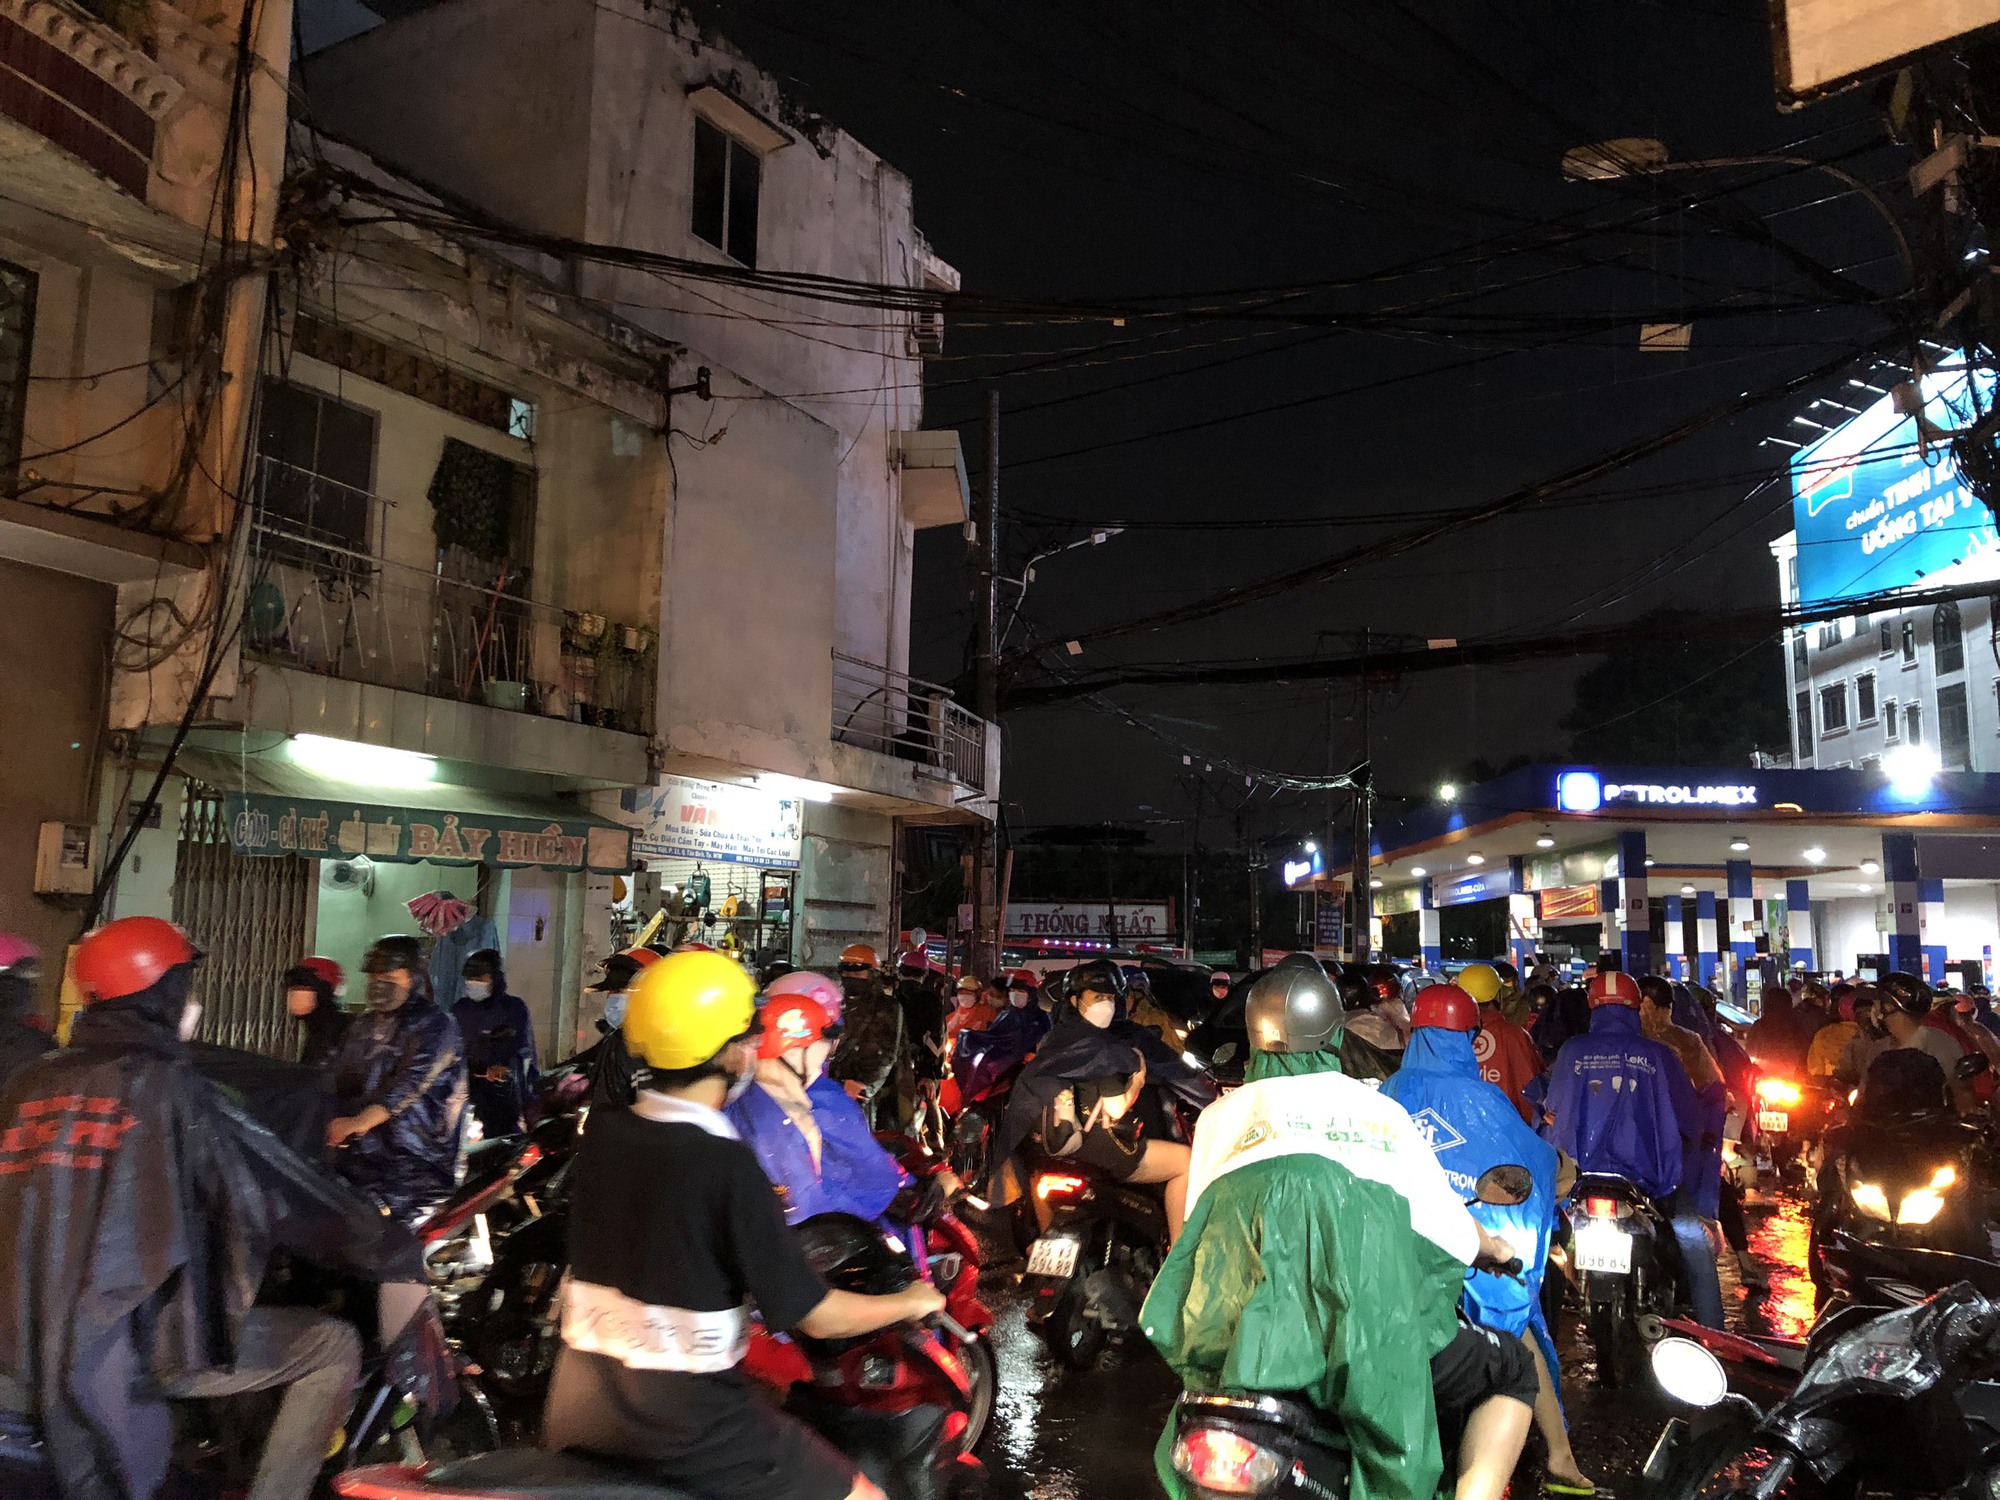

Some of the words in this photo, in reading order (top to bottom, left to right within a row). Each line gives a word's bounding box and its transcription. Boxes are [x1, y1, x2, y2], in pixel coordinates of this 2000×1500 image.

[407, 813, 492, 861] BẢY
[1020, 905, 1090, 933] THỐNG
[1098, 908, 1156, 935] NHẤT
